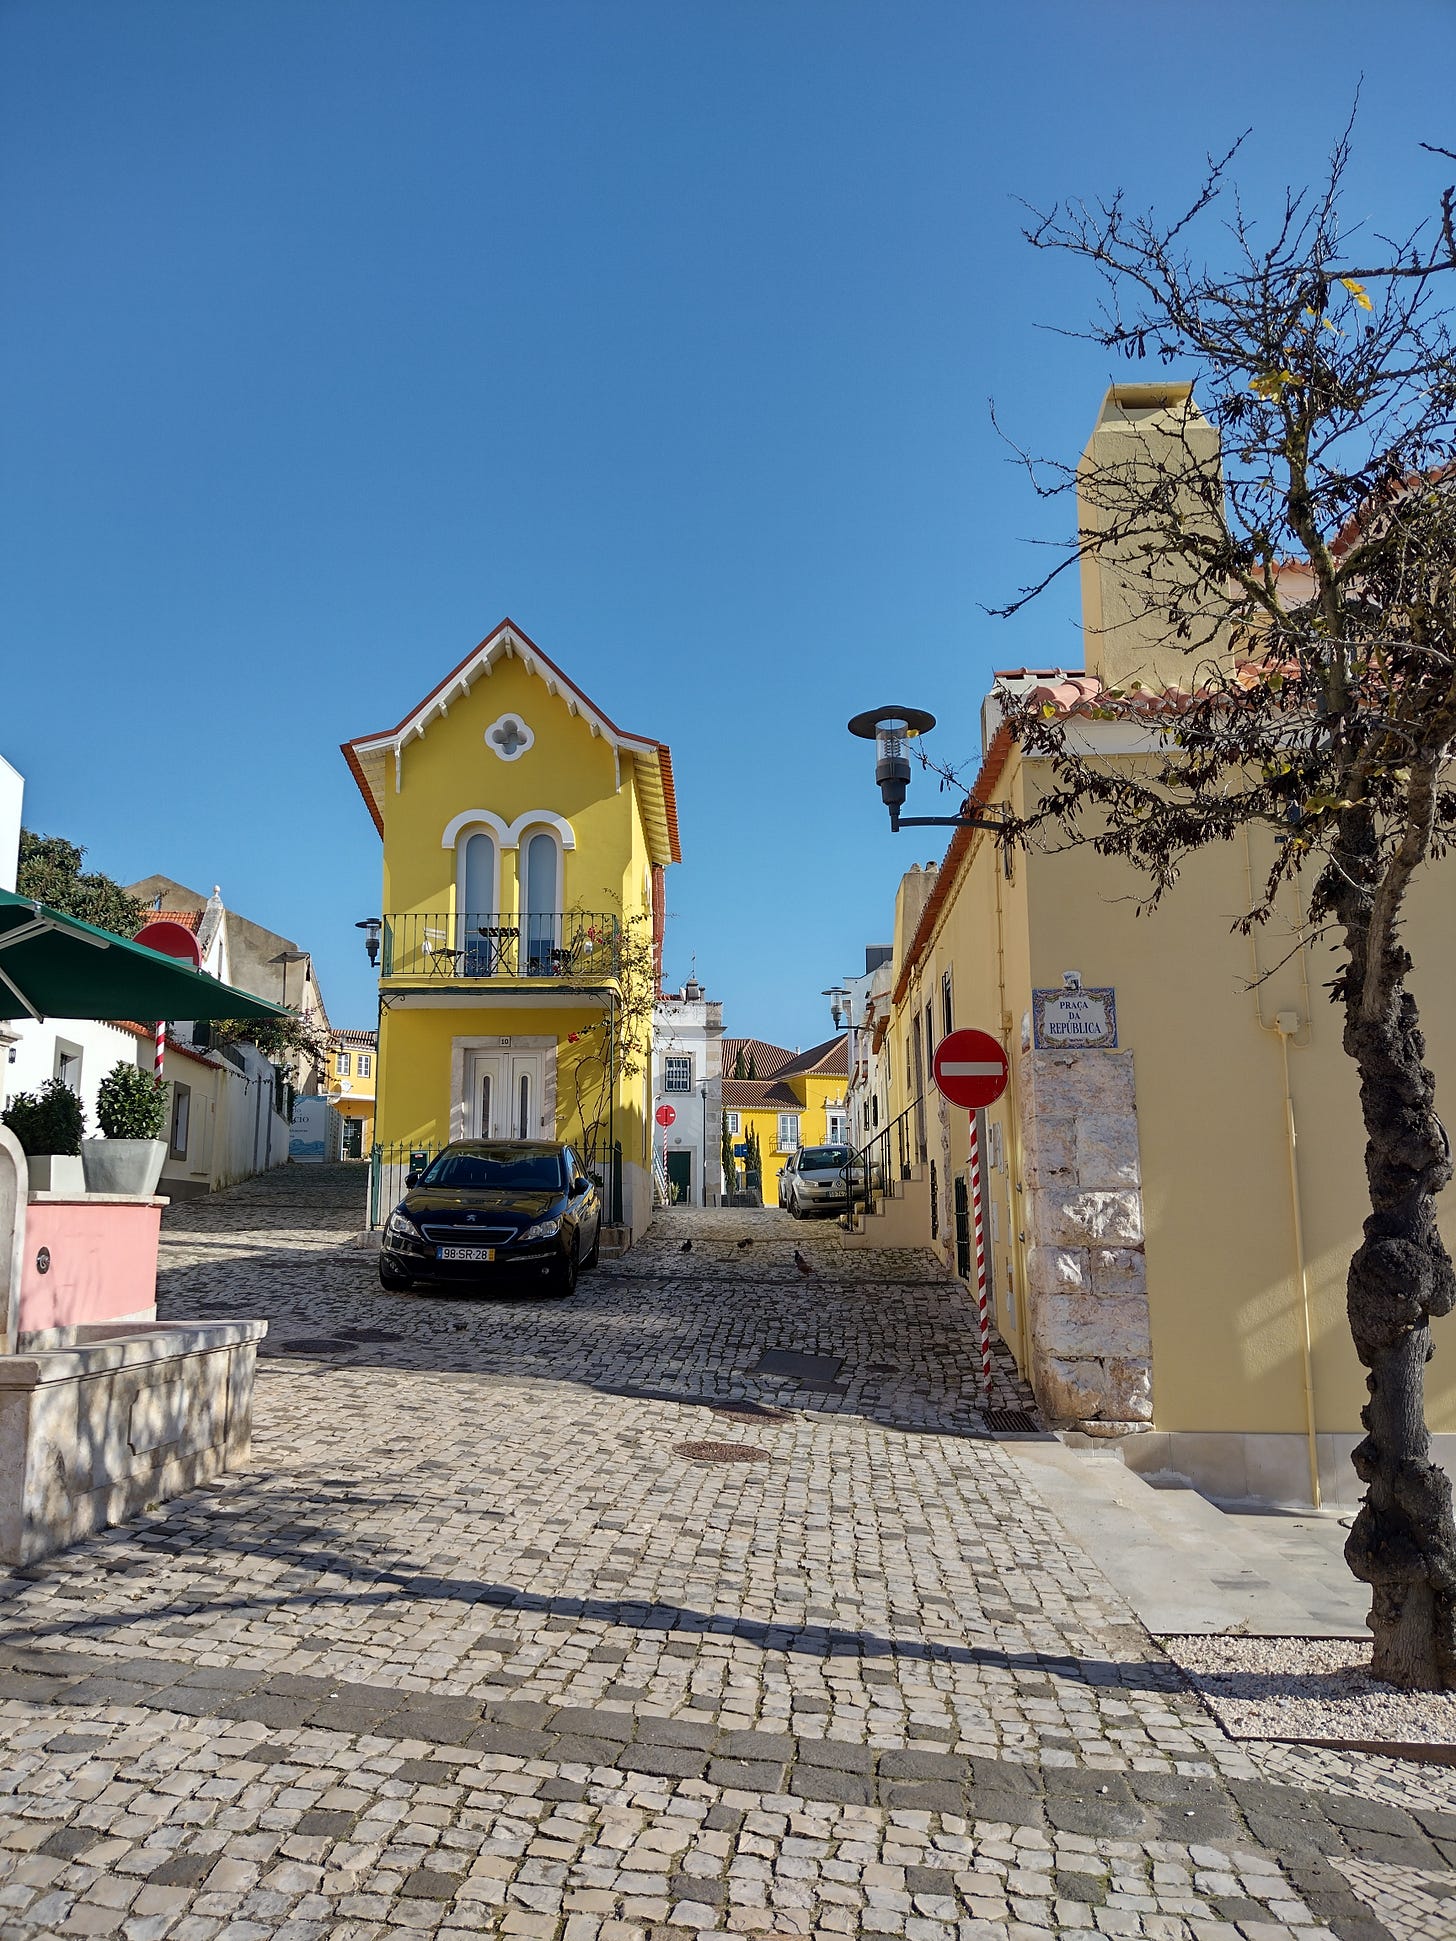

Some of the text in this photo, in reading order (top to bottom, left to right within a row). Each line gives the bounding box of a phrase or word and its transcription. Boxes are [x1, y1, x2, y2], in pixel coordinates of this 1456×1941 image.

[1059, 1001, 1089, 1011] PRAÇA
[1068, 1011, 1081, 1020] DA
[1049, 1020, 1102, 1035] REPÚBLICA
[443, 1248, 488, 1260] 98-SR-28
